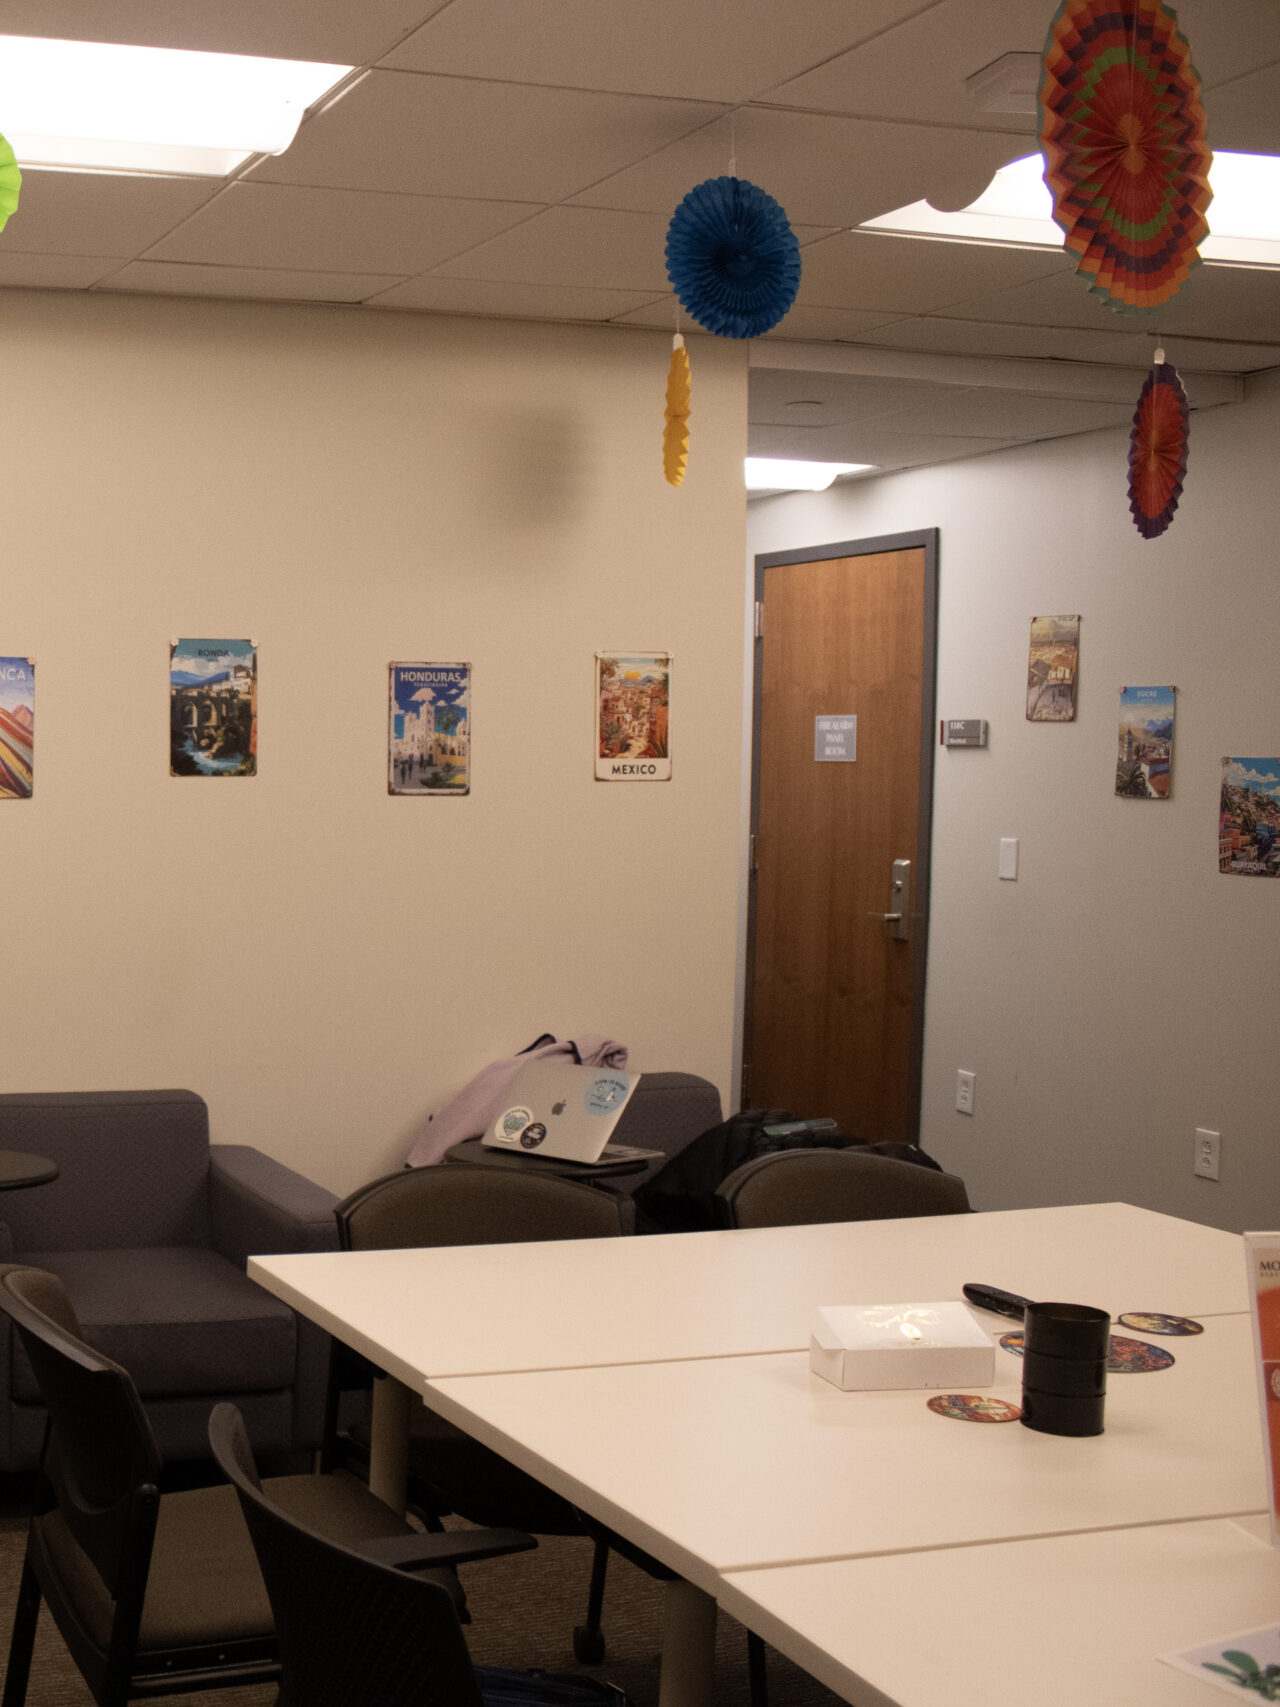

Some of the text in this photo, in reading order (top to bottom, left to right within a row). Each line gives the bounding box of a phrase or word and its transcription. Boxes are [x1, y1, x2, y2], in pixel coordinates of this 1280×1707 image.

[197, 649, 230, 657] RONDA
[400, 671, 461, 682] HONDURAS
[611, 764, 657, 775] MEXICO
